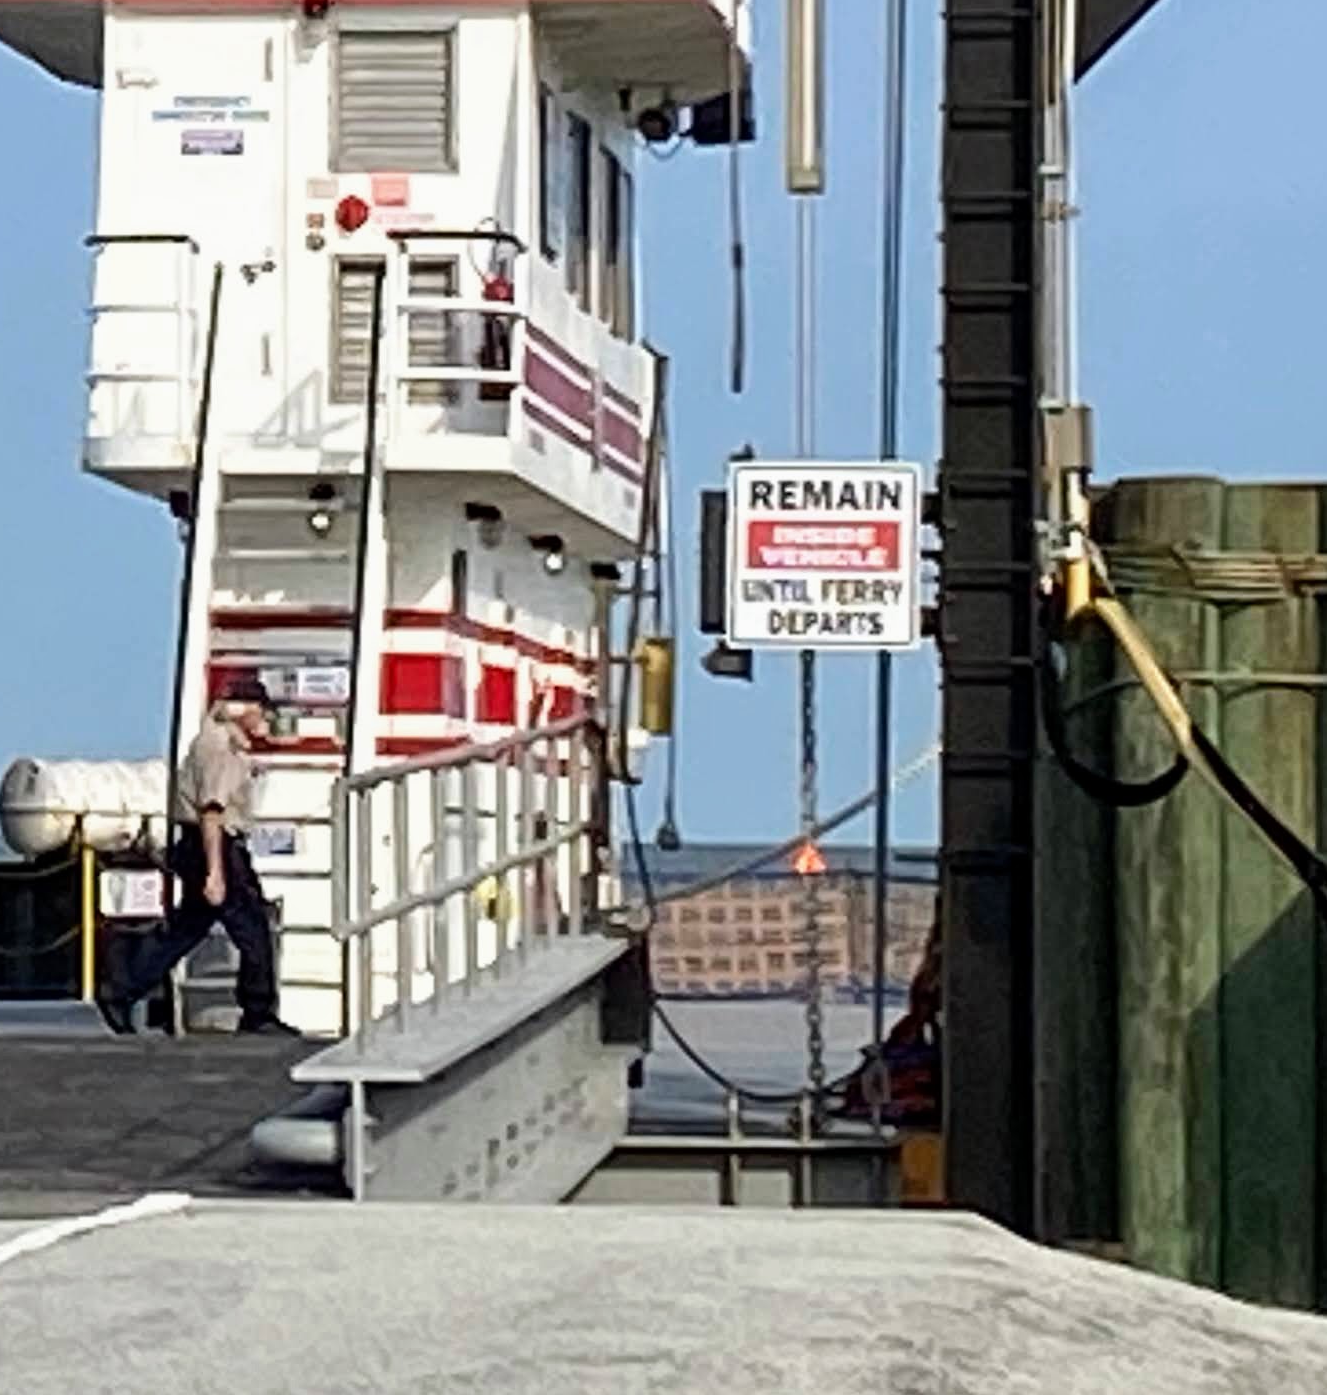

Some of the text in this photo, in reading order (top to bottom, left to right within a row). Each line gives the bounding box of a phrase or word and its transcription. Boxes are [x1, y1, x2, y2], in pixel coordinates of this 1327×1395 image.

[748, 480, 903, 510] REMAIN
[741, 579, 903, 605] UNTIL FERRY
[768, 609, 885, 635] DEPARTS
